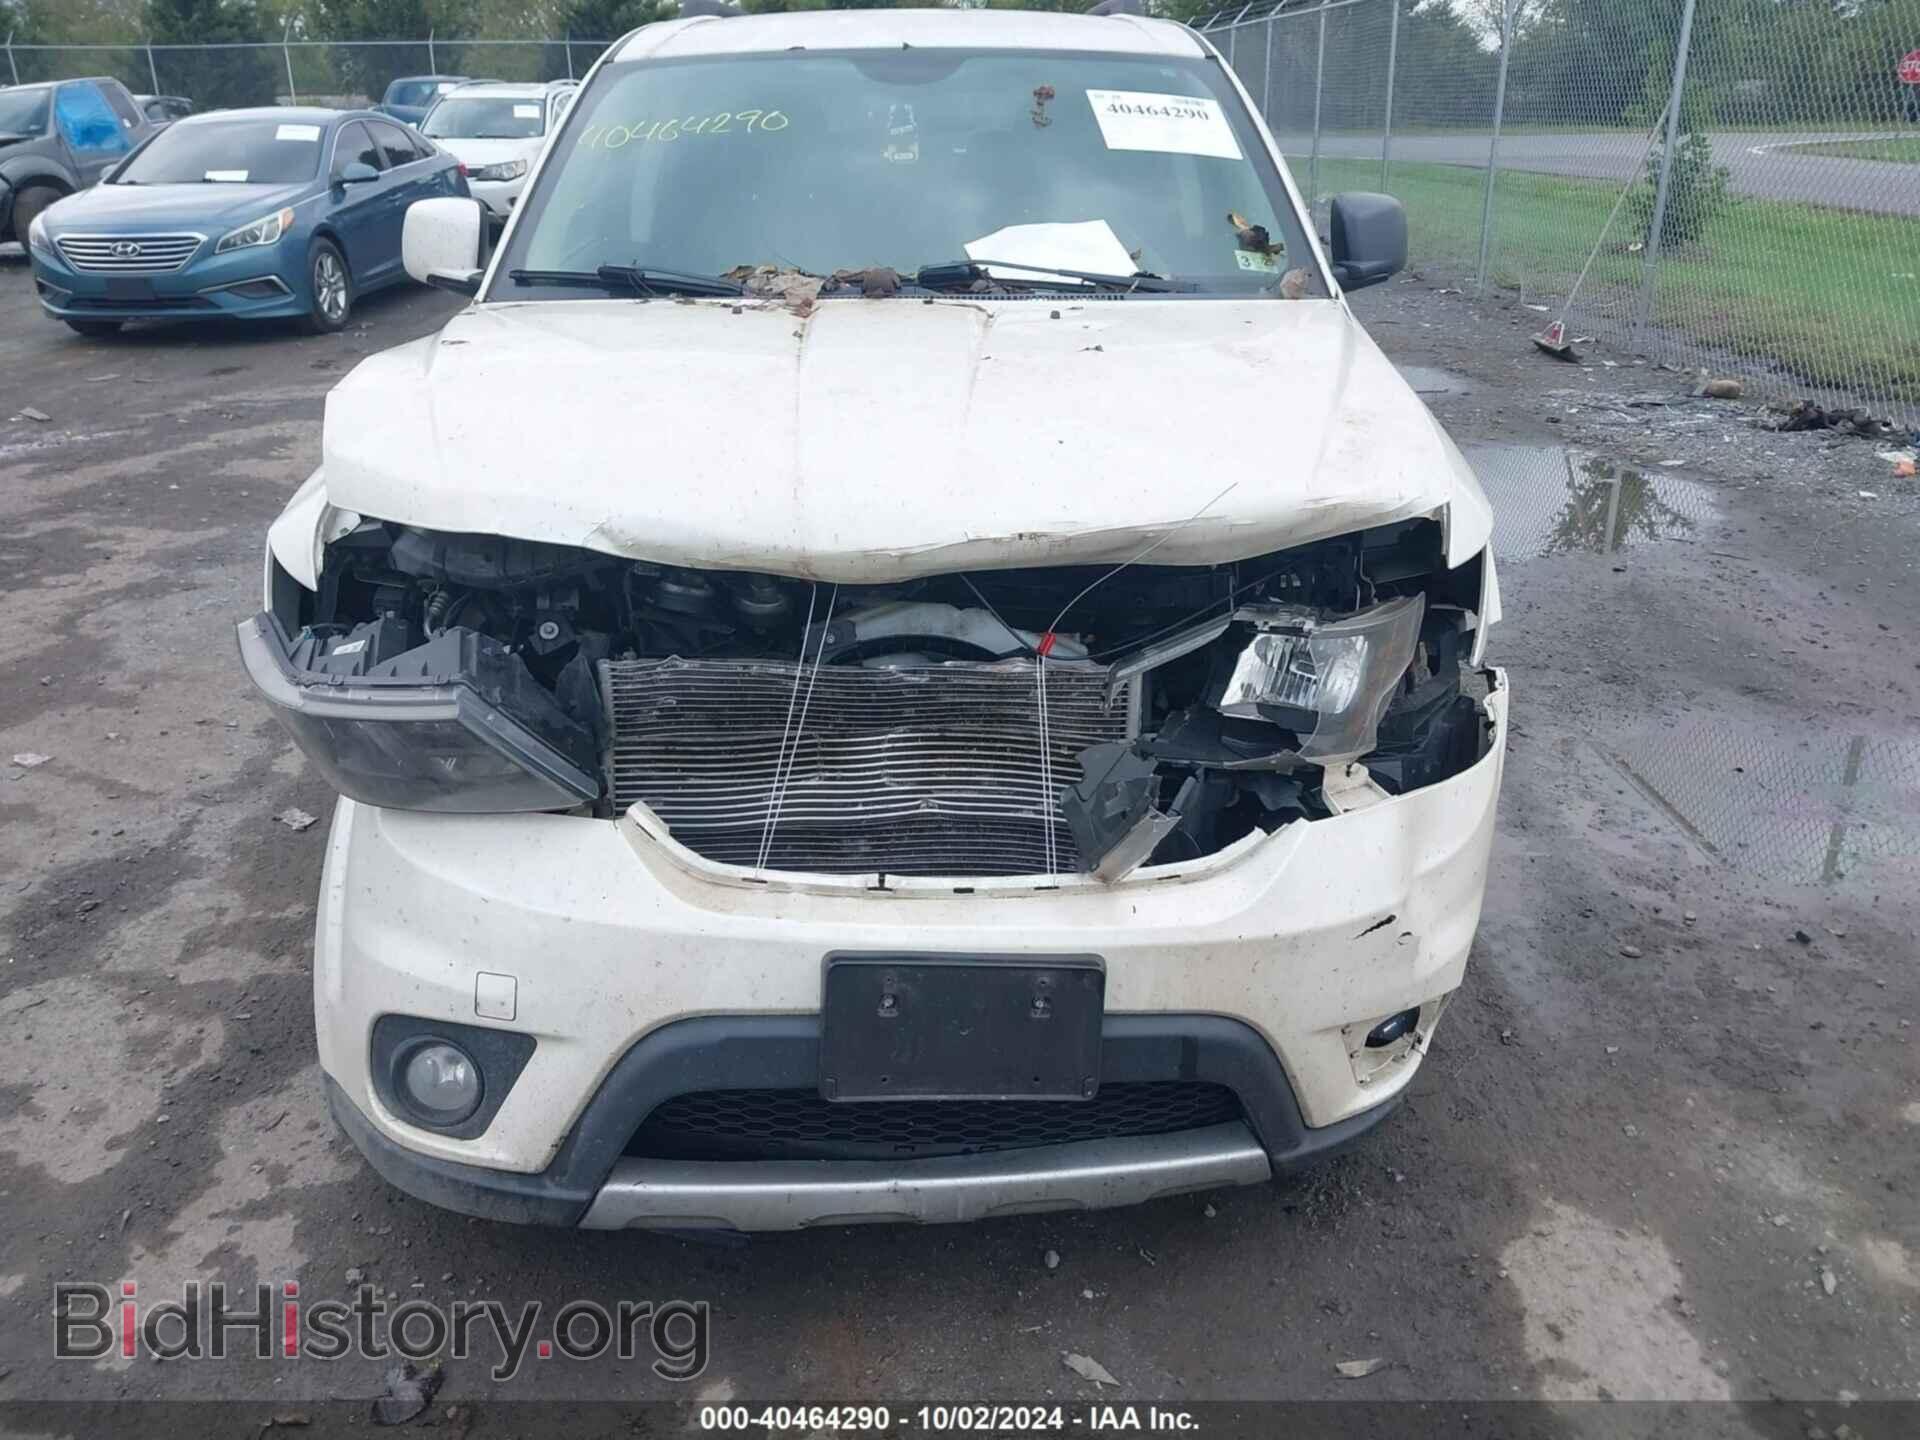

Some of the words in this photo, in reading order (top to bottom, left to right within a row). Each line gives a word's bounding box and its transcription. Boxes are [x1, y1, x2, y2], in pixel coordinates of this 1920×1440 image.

[1902, 60, 1920, 73] STO
[1106, 102, 1210, 121] 40464290
[577, 109, 790, 150] 40464290
